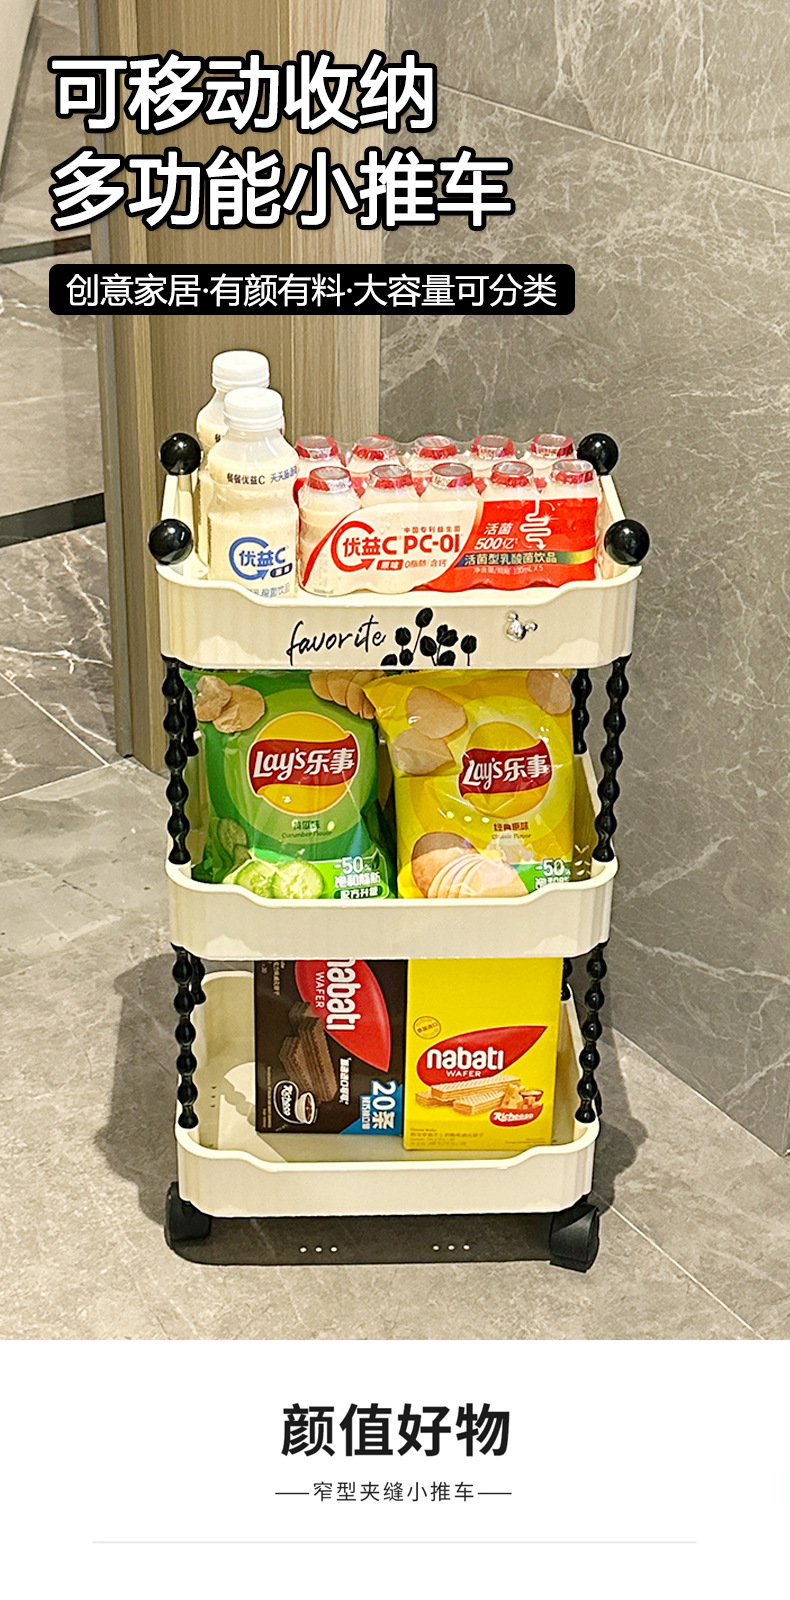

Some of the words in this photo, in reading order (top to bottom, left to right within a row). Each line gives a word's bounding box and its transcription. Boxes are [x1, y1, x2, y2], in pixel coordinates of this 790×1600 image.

[483, 522, 514, 535] 活菌
[238, 546, 286, 568] 优益C
[342, 535, 398, 557] 优益C
[464, 551, 558, 566] 活菌型乳酸菌饮品
[286, 614, 387, 667] favorite
[315, 971, 325, 1008] WAFER
[426, 1046, 504, 1070] nabati
[446, 1070, 482, 1078] WAFER
